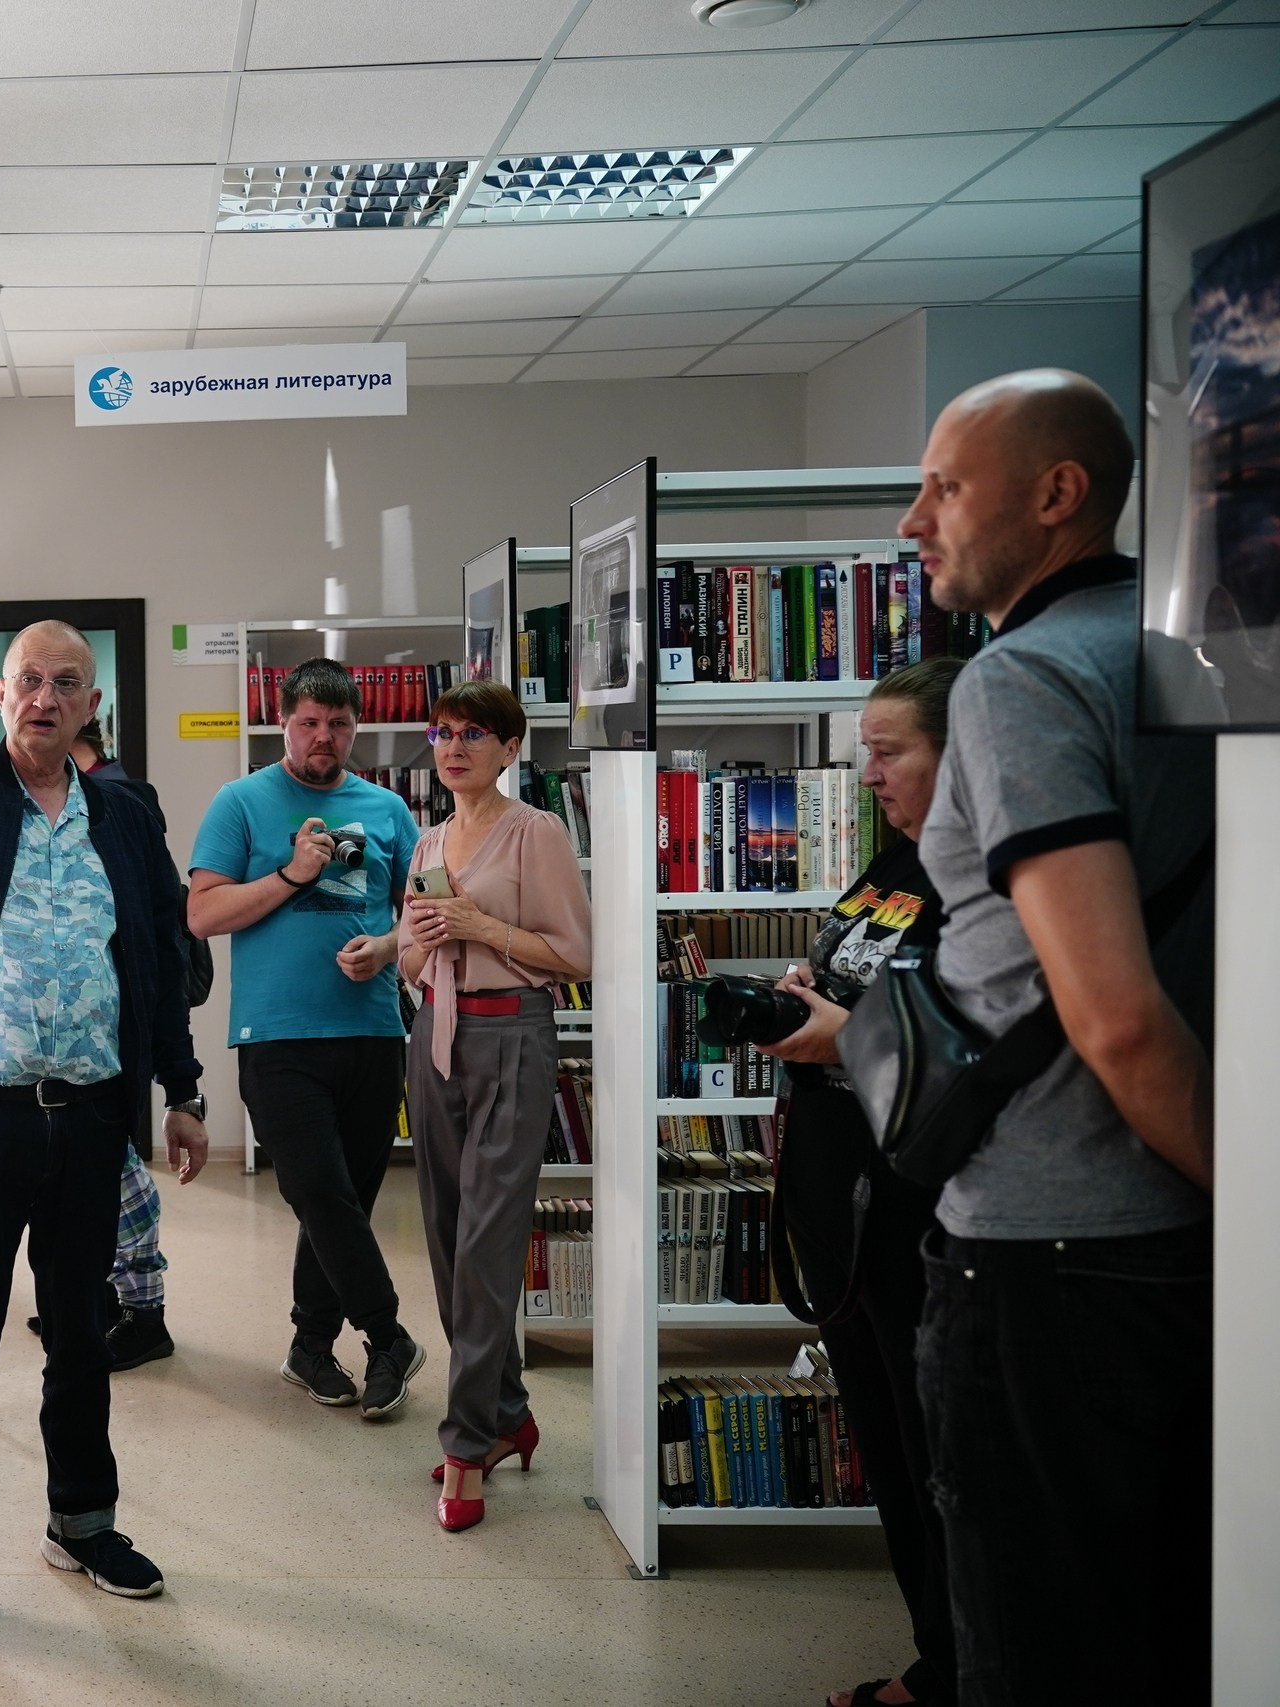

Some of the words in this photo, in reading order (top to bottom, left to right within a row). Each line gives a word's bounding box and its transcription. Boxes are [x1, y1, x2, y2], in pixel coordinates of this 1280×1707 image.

[149, 375, 269, 396] зарубежная
[274, 371, 393, 390] литература
[662, 581, 671, 629] НАПОЛЕОН
[698, 575, 708, 637] РАДЗИНСКИЙ
[737, 588, 749, 636] СТАЛИН
[669, 653, 682, 670] Р
[526, 682, 536, 695] Н
[713, 789, 722, 823] ОЛЕГ
[727, 795, 736, 823] РОЙ
[738, 784, 746, 810] ОЛЕГ
[798, 786, 809, 811] Рой
[812, 798, 820, 826] РОЙ
[713, 824, 722, 851] РОЙ
[738, 814, 747, 837] РОЙ
[687, 838, 695, 864] ПОРОГ
[712, 1070, 724, 1086] С
[748, 1065, 756, 1090] ТЕМНЫЕ
[762, 1064, 770, 1090] ТЕМНЫЕ
[534, 1294, 544, 1307] С
